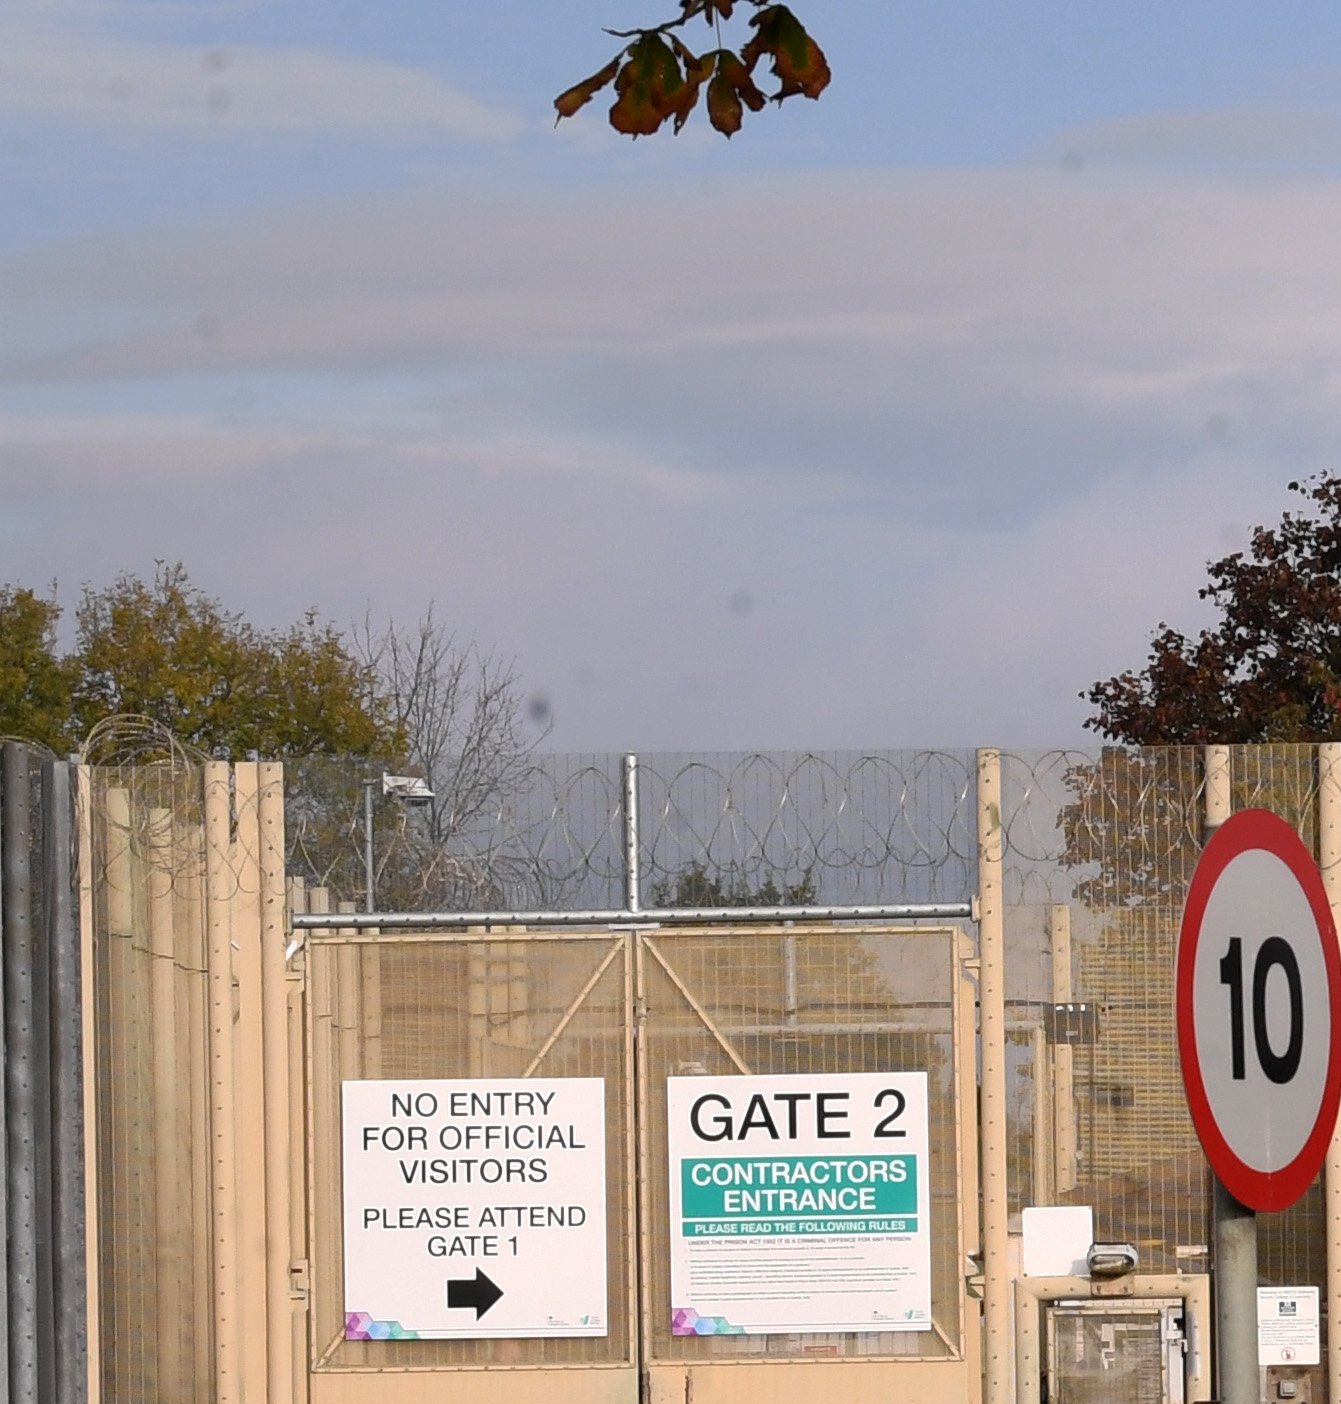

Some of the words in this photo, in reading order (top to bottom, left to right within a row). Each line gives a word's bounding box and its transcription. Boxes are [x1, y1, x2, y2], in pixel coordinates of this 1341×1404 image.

[1219, 936, 1304, 1085] 10
[391, 1092, 438, 1118] NO
[450, 1091, 556, 1117] ENTRY
[690, 1092, 851, 1142] GATE
[873, 1088, 907, 1138] 2
[363, 1126, 428, 1151] FOR
[439, 1124, 586, 1151] OFFICIAL
[399, 1158, 548, 1184] VISITORS
[691, 1159, 907, 1187] CONTRACTORS
[724, 1187, 877, 1213] ENTRANCE
[363, 1207, 470, 1229] PLEASE
[478, 1206, 586, 1228] ATTEND
[694, 1223, 738, 1234] PLEASE
[740, 1222, 772, 1234] READ
[773, 1222, 797, 1233] THE
[798, 1220, 866, 1233] FOLLOWING
[868, 1220, 906, 1232] RULES
[427, 1235, 499, 1257] GATE
[508, 1235, 518, 1256] 1
